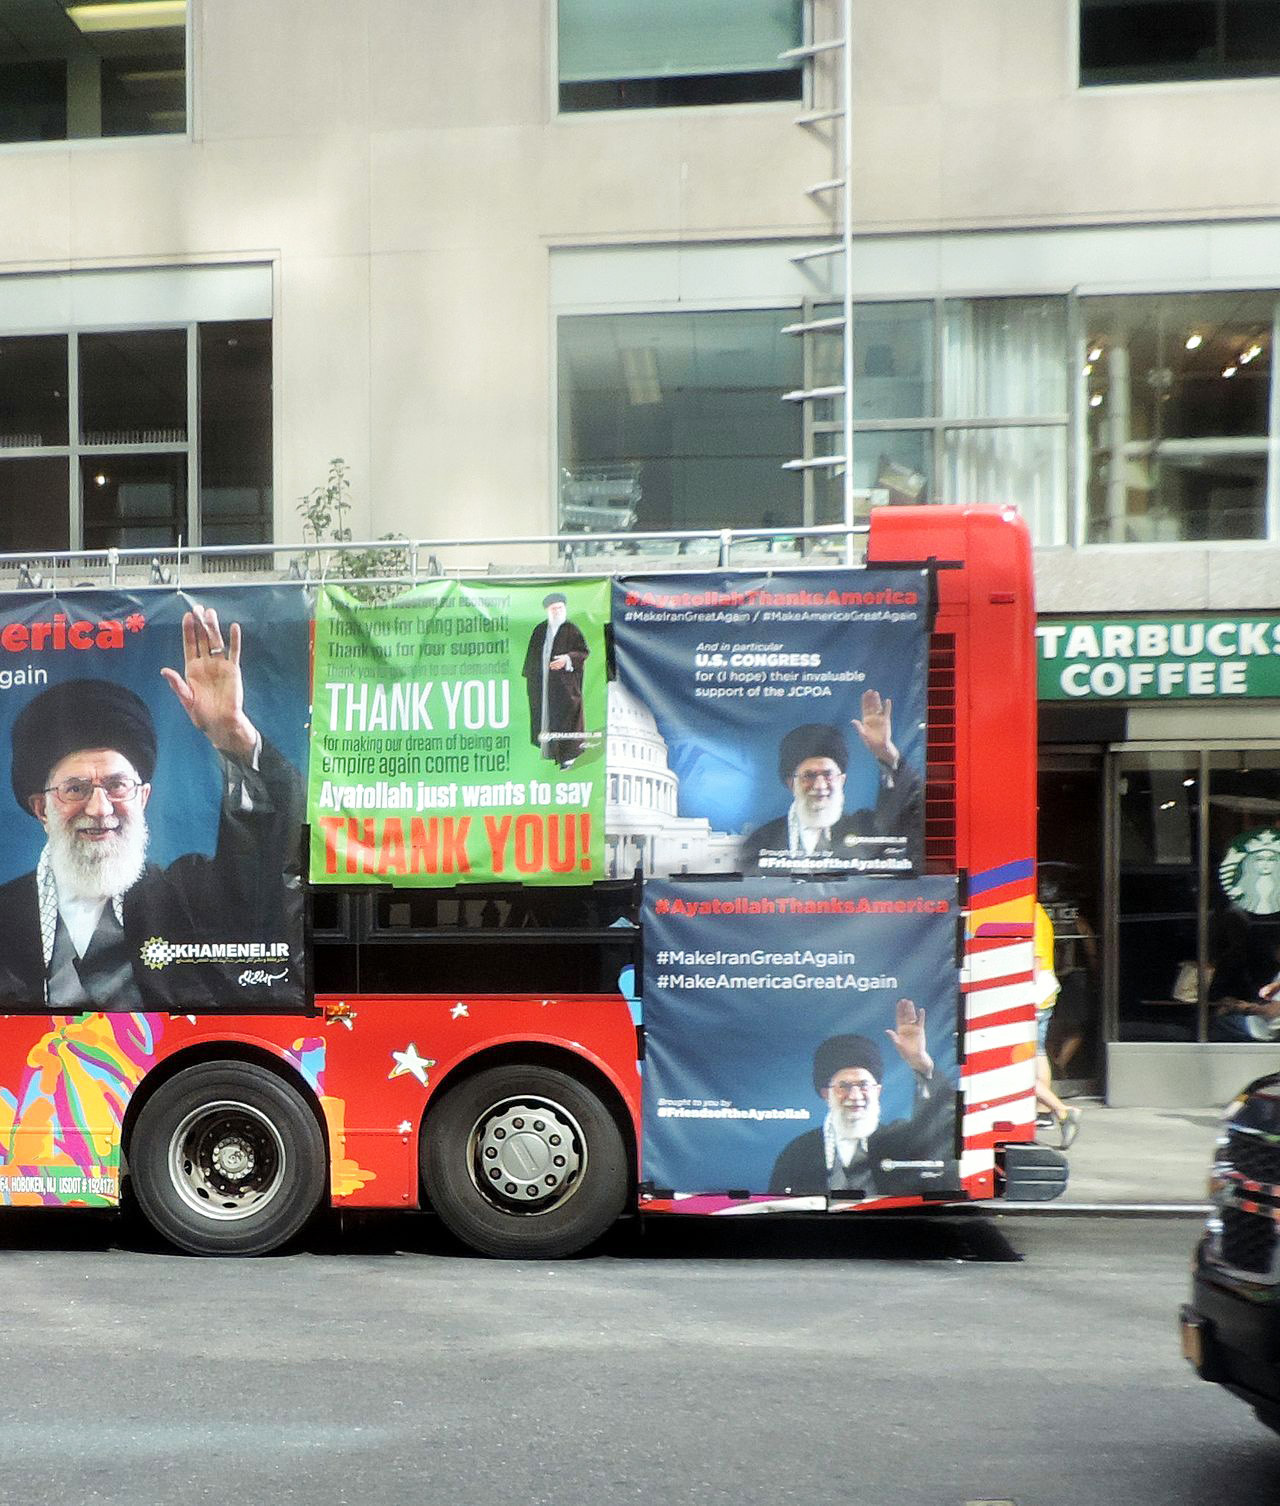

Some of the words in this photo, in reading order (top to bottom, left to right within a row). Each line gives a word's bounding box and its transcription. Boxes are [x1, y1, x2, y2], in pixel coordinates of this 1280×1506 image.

[625, 588, 918, 609] #AyatollahThanksAmerica
[624, 611, 751, 623] #MakeIranGreatAgain
[752, 611, 760, 622] /
[763, 611, 918, 623] #MakeAmericaGreatAgain
[369, 622, 391, 637] you
[393, 618, 413, 635] for
[328, 641, 368, 658] Thank
[396, 641, 415, 656] for
[450, 638, 509, 657] support!
[696, 642, 719, 651] And
[721, 642, 731, 651] in
[732, 642, 784, 653] particular
[695, 653, 728, 667] U.S.
[730, 653, 822, 668] CONGRESS
[695, 670, 714, 682] for
[730, 670, 767, 683] hope)
[770, 670, 798, 682] their
[801, 670, 866, 682] invaluable
[1060, 662, 1248, 696] COFFEE
[695, 686, 744, 698] support
[747, 685, 761, 697] of
[766, 685, 786, 697] the
[787, 685, 832, 697] JCPOA
[325, 681, 435, 731] THANK
[442, 679, 510, 729] YOU
[323, 735, 339, 750] for
[342, 735, 382, 753] making
[385, 738, 403, 751] our
[406, 735, 443, 751] dream
[446, 735, 459, 750] of
[459, 734, 493, 752] being
[494, 736, 510, 749] an
[322, 755, 376, 777] empire
[379, 755, 422, 777] again
[425, 756, 470, 773] come
[473, 751, 510, 772] true!
[320, 781, 414, 811] Ayatollah
[417, 781, 458, 812] just
[462, 781, 525, 807] wants
[529, 780, 551, 806] to
[556, 782, 593, 808] say
[320, 816, 473, 875] THANK
[484, 813, 593, 873] YOU!
[655, 896, 950, 919] #AyatollahThanksAmerica
[175, 943, 290, 957] KHAMENEI.IR
[656, 950, 855, 967] #MakeIranGreatAgain
[657, 974, 897, 990] #MakeAmericaGreatAgain
[657, 1107, 811, 1121] #FriendsoftheAyatollah
[11, 1177, 46, 1195] HOBOKEN,
[46, 1177, 57, 1193] NJ
[59, 1178, 82, 1193] USDOT
